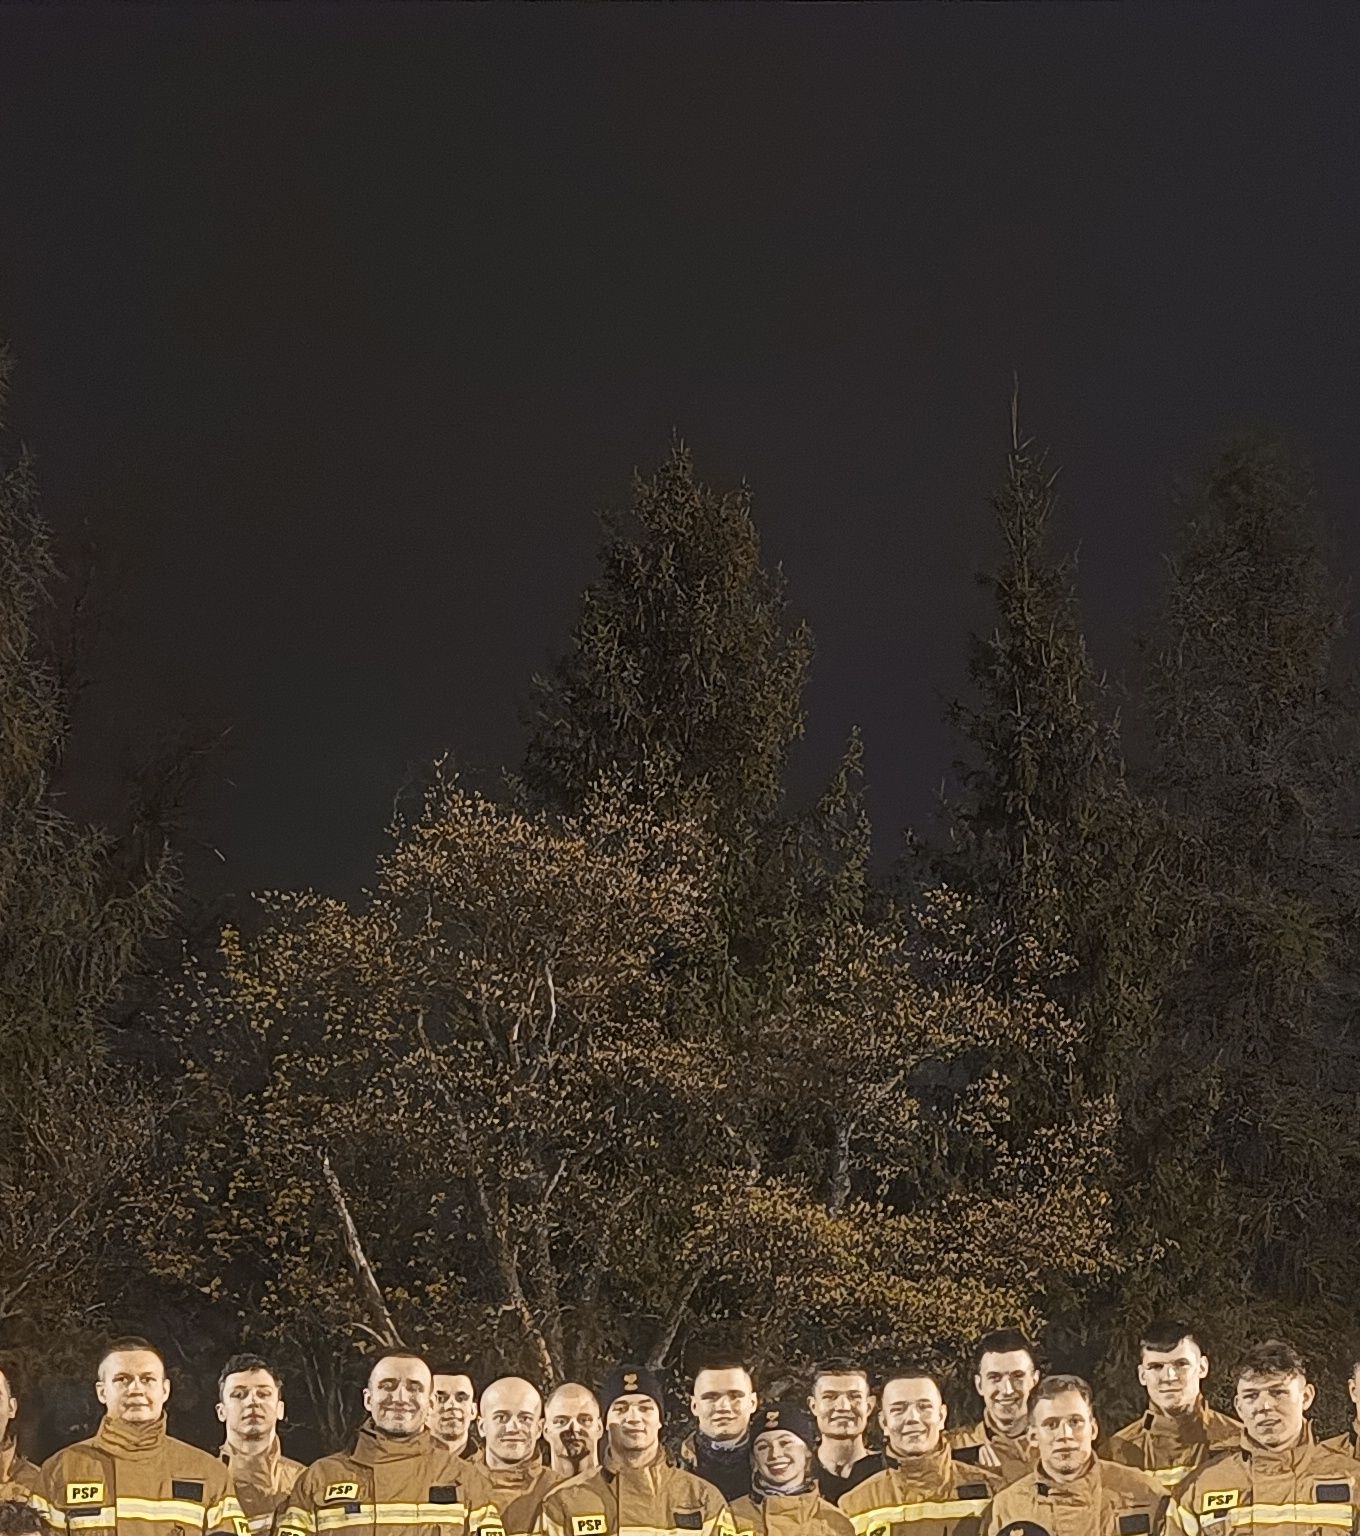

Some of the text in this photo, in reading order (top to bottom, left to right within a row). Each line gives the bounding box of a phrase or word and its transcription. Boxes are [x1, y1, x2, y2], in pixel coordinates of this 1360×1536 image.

[72, 1487, 99, 1500] PSP
[329, 1485, 353, 1496] PSP
[1207, 1494, 1233, 1507] PSP
[578, 1519, 602, 1532] PSP
